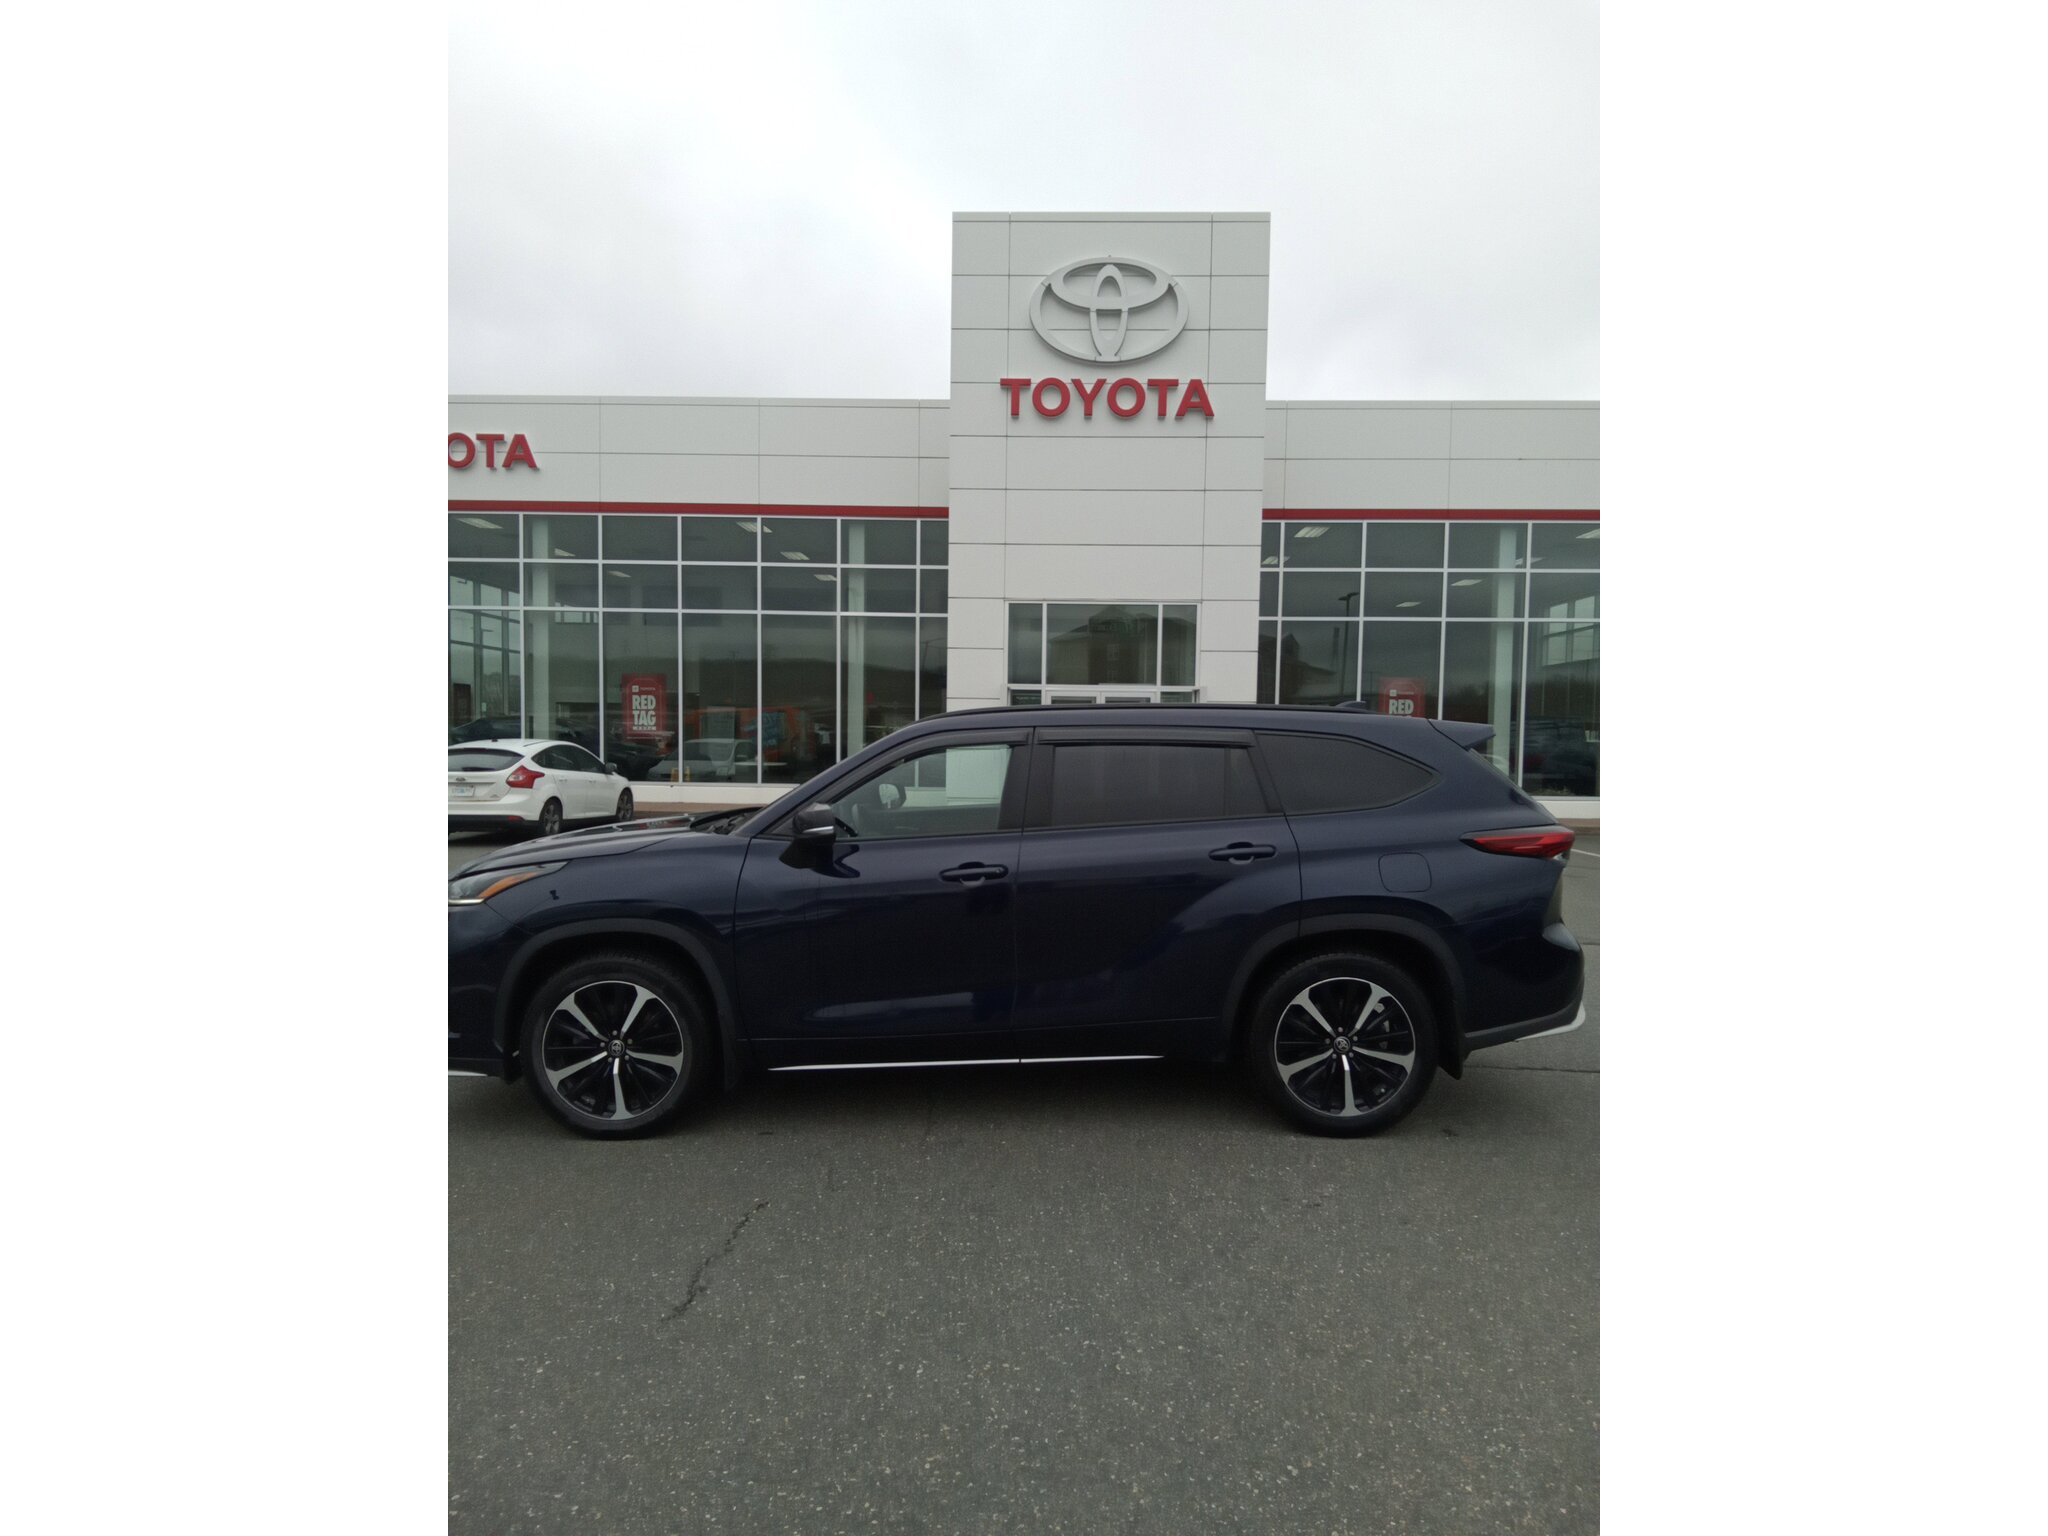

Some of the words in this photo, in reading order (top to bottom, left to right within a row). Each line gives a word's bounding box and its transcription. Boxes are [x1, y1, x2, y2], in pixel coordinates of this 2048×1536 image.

[1000, 377, 1215, 418] TOYOTA
[448, 432, 538, 469] OTA
[632, 695, 656, 710] RED
[1389, 699, 1414, 715] RED
[632, 710, 656, 726] TAG
